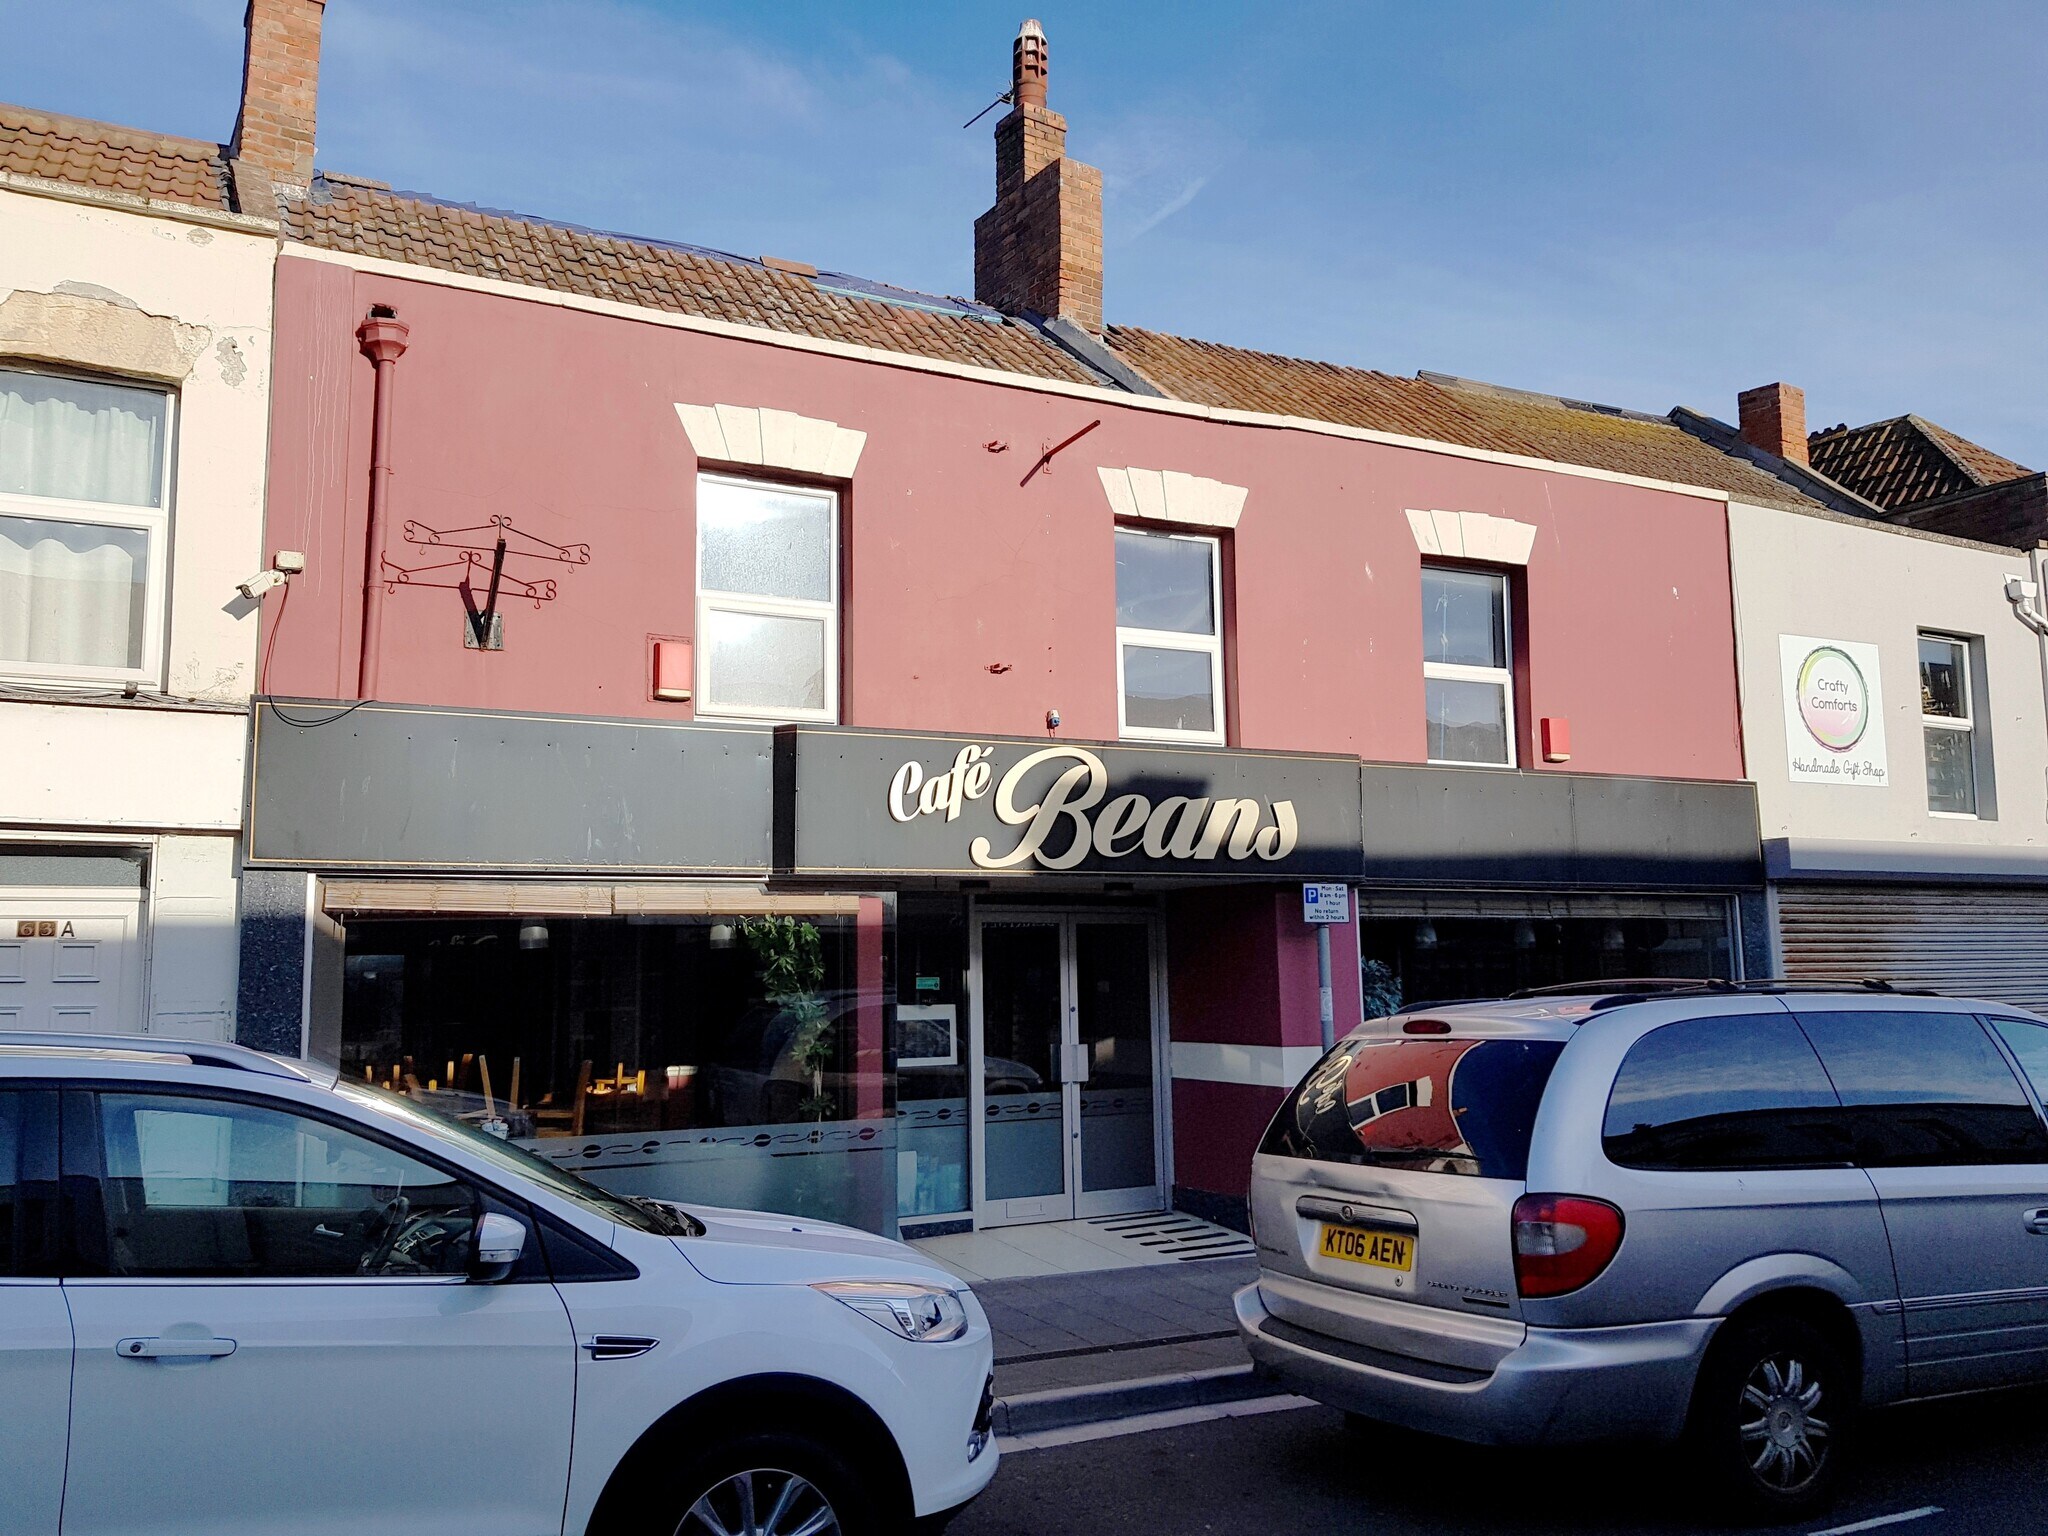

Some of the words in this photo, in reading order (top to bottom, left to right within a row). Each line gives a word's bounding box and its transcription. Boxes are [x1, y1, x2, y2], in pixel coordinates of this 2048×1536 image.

[1817, 678, 1849, 695] Crafty
[1811, 696, 1858, 712] Comforts
[1792, 757, 1840, 775] Handmade
[1843, 759, 1861, 780] Gift
[1862, 760, 1886, 783] Shop
[888, 744, 994, 823] Café
[970, 746, 1299, 870] Beans
[1308, 890, 1316, 902] P
[1325, 1228, 1365, 1257] KT06
[1368, 1235, 1405, 1265] AEN
